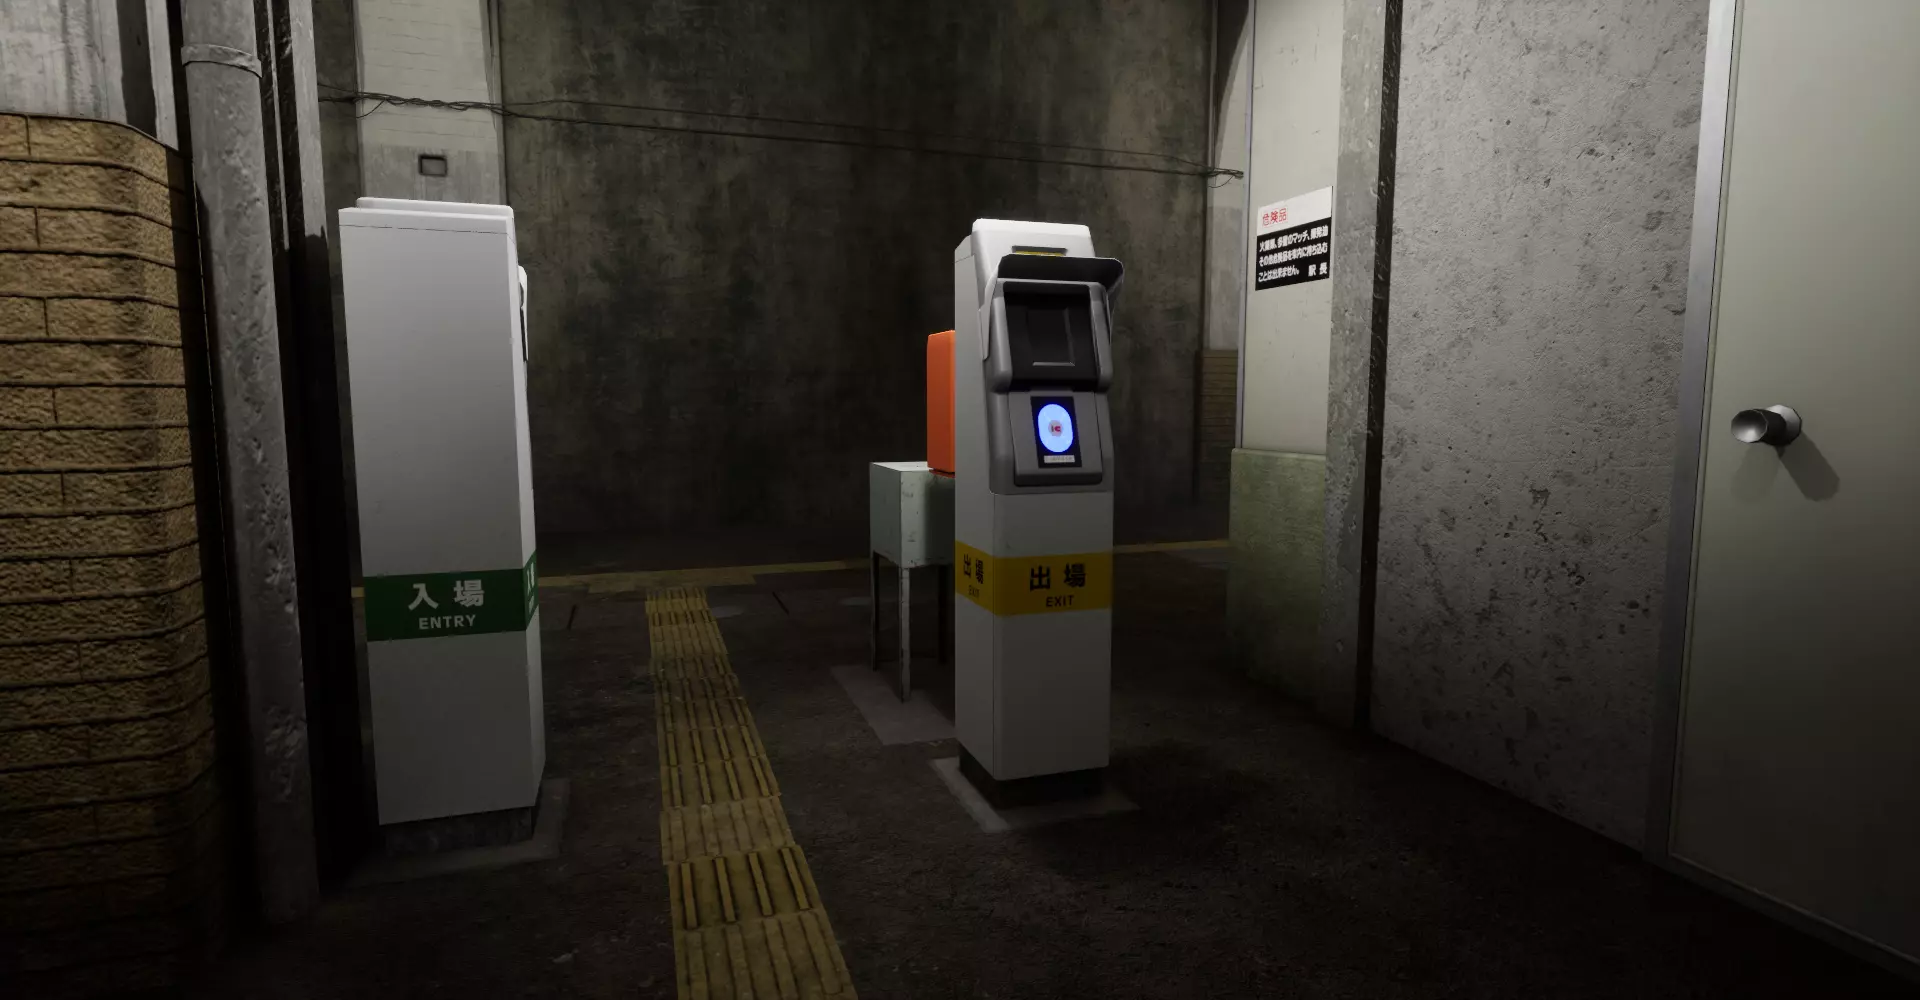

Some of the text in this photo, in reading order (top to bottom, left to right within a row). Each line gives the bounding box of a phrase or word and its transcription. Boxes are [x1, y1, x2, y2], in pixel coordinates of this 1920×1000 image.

[1029, 562, 1087, 592] 出場
[407, 579, 485, 611] 入場
[1045, 595, 1075, 608] EXIT
[418, 614, 476, 630] ENTRY
